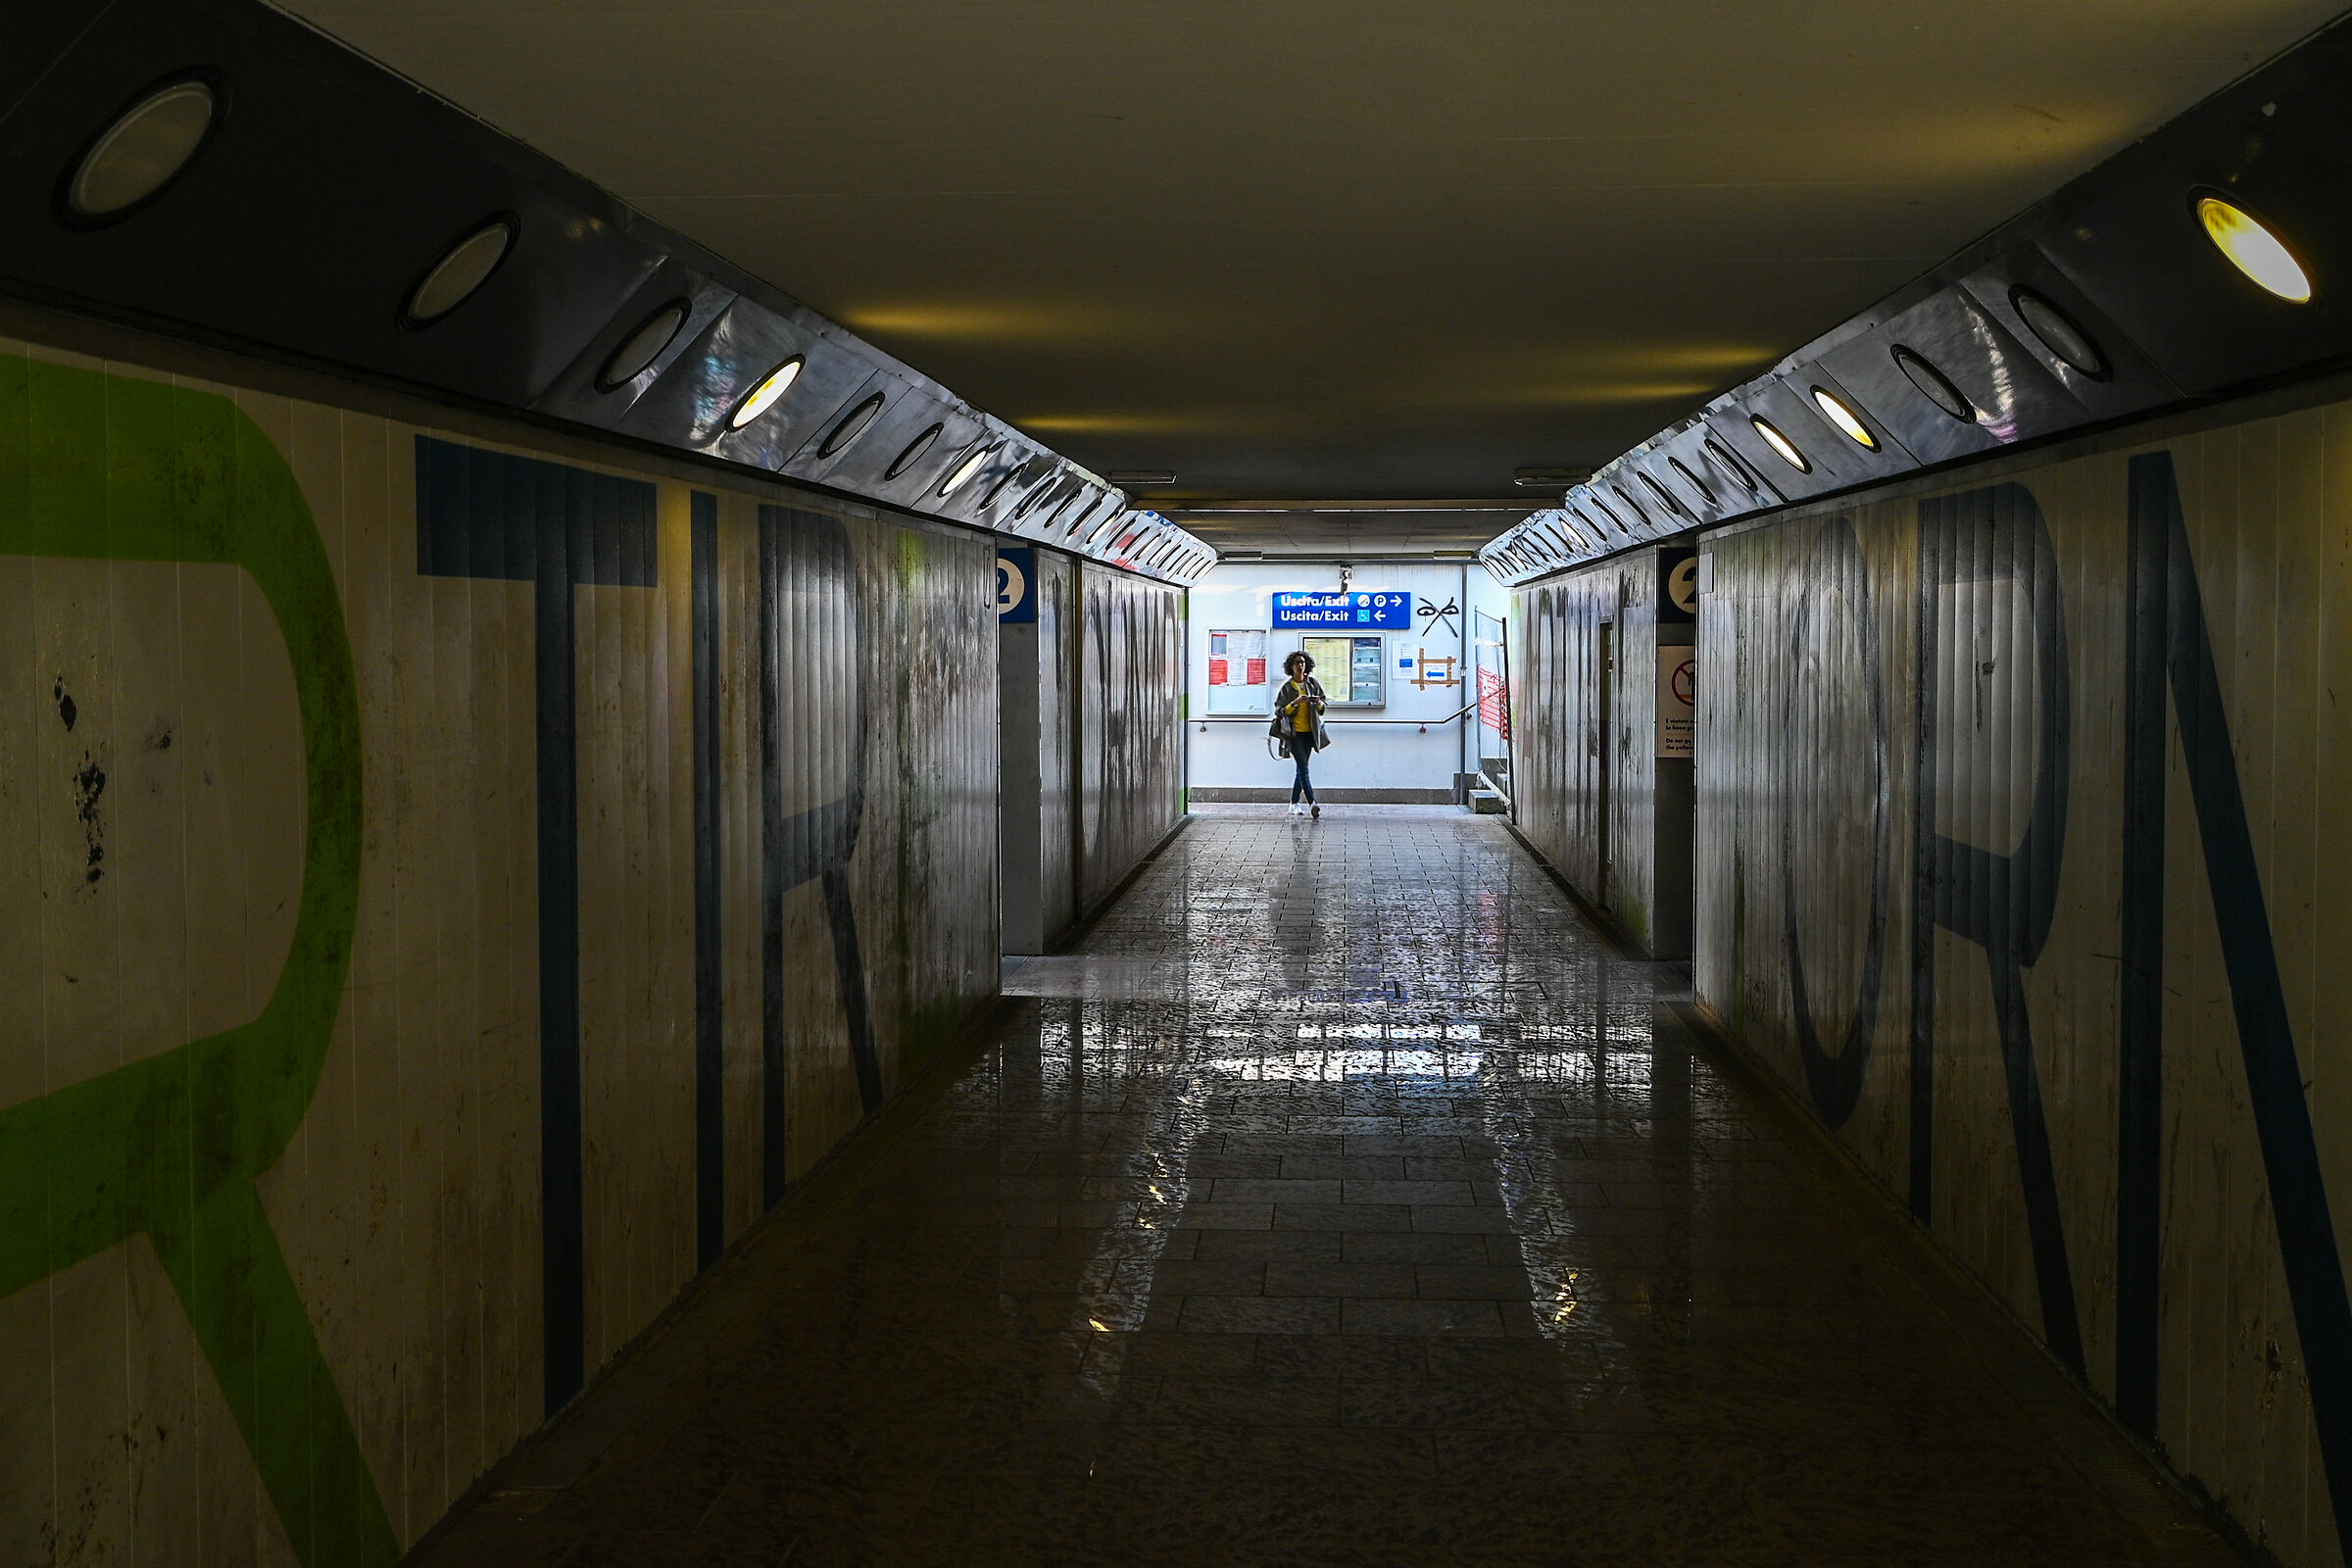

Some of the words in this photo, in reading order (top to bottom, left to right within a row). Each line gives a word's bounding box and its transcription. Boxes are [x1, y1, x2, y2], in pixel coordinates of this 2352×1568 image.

[997, 566, 1010, 605] 2
[1280, 595, 1349, 607] Uscita/Exit
[1280, 610, 1349, 621] Uscita/Exit
